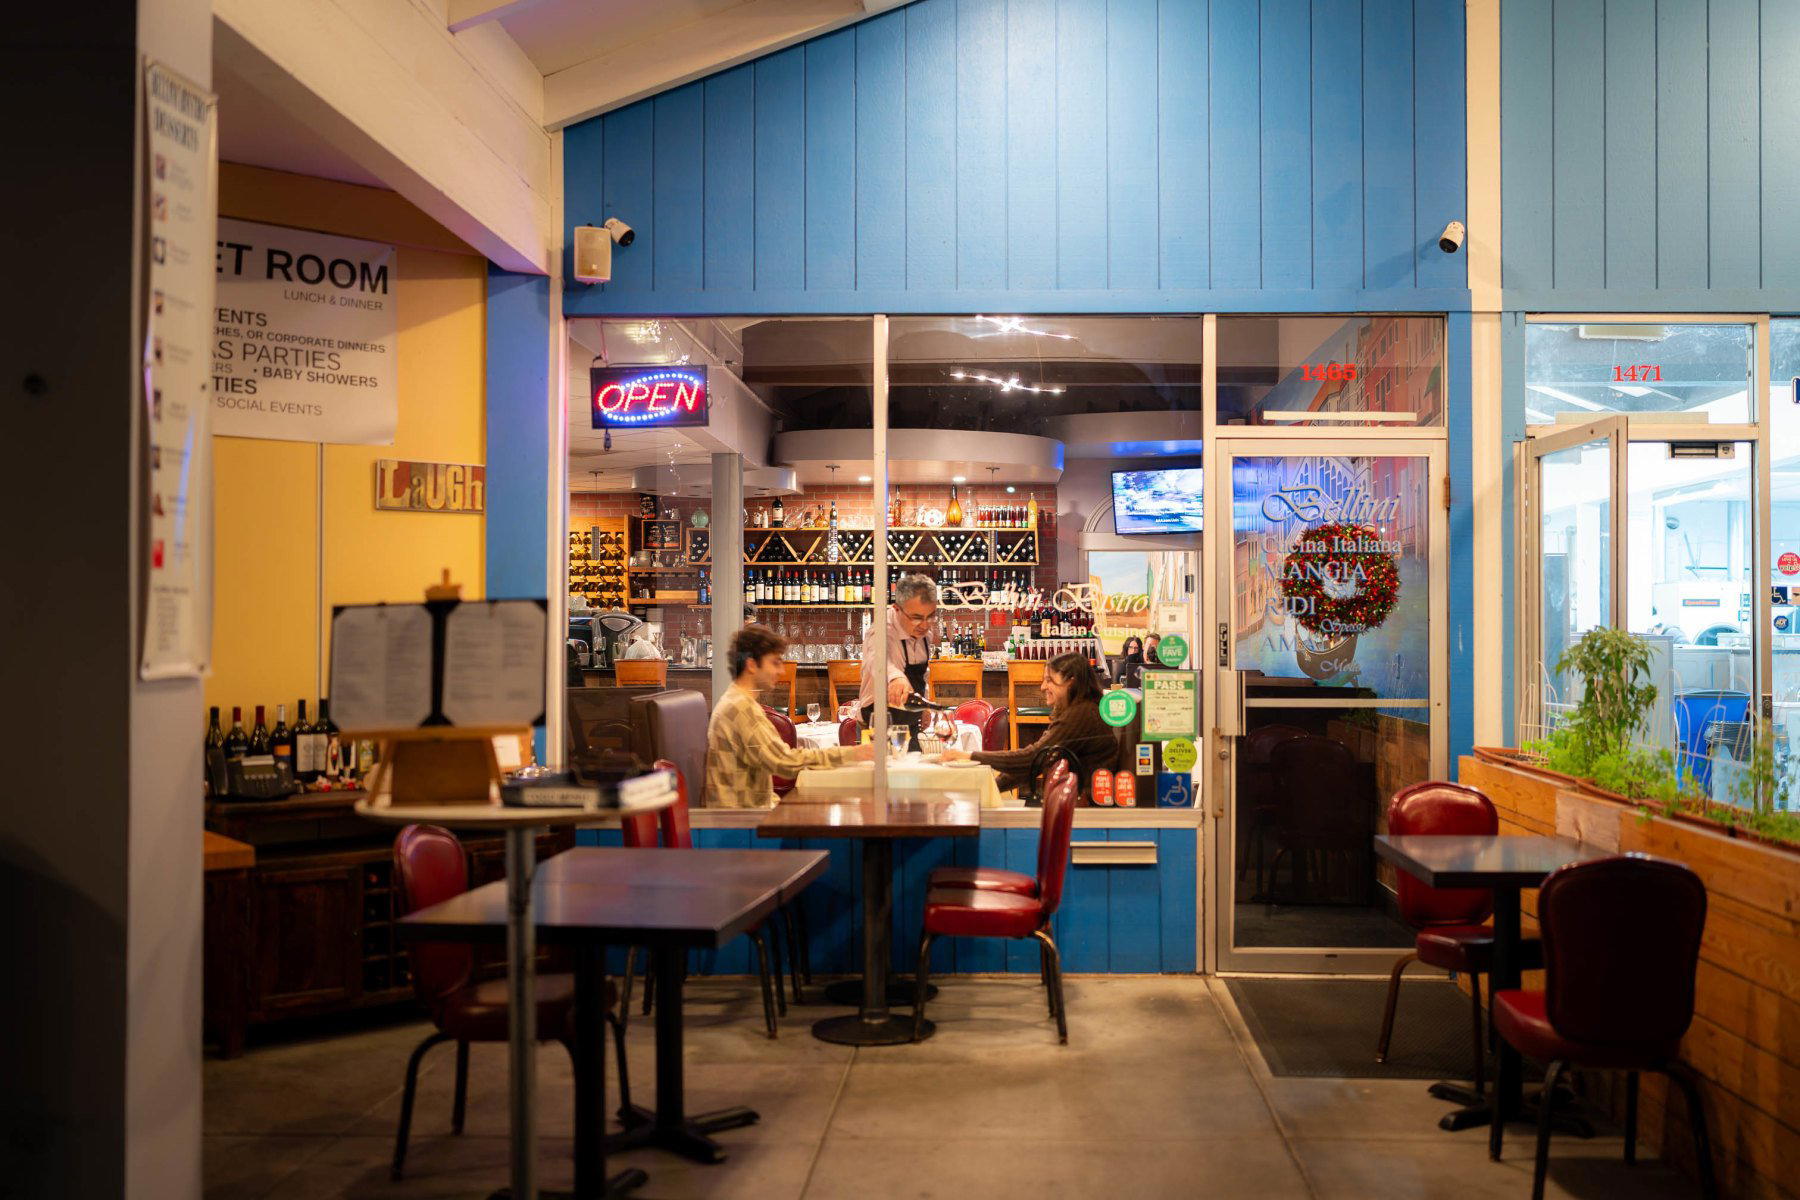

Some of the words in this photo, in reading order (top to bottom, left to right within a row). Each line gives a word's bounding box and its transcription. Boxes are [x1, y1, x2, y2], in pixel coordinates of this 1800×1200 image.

[266, 248, 388, 295] ROOM
[284, 290, 326, 304] LUNCH
[329, 295, 336, 305] &
[340, 296, 383, 311] DINNER
[214, 308, 267, 327] ENTS
[246, 329, 263, 339] OR
[266, 332, 334, 348] CORPORATE
[337, 340, 386, 354] DINNERS
[212, 340, 233, 360] S
[242, 343, 341, 371] PARTIES
[263, 366, 302, 380] BABY
[306, 371, 378, 388] SHOWERS
[1300, 362, 1358, 382] 1465
[1612, 365, 1665, 383] 1471
[217, 397, 265, 411] SOCIAL
[270, 401, 323, 416] EVENTS
[597, 381, 700, 412] OPEN
[1261, 484, 1403, 523] Bellini
[1332, 534, 1402, 554] Italiana
[938, 581, 1043, 612] Bellini
[1052, 582, 1150, 613] Bistro
[1041, 619, 1088, 638] Italian
[1162, 648, 1183, 657] FAVE
[1153, 680, 1186, 690] PASS
